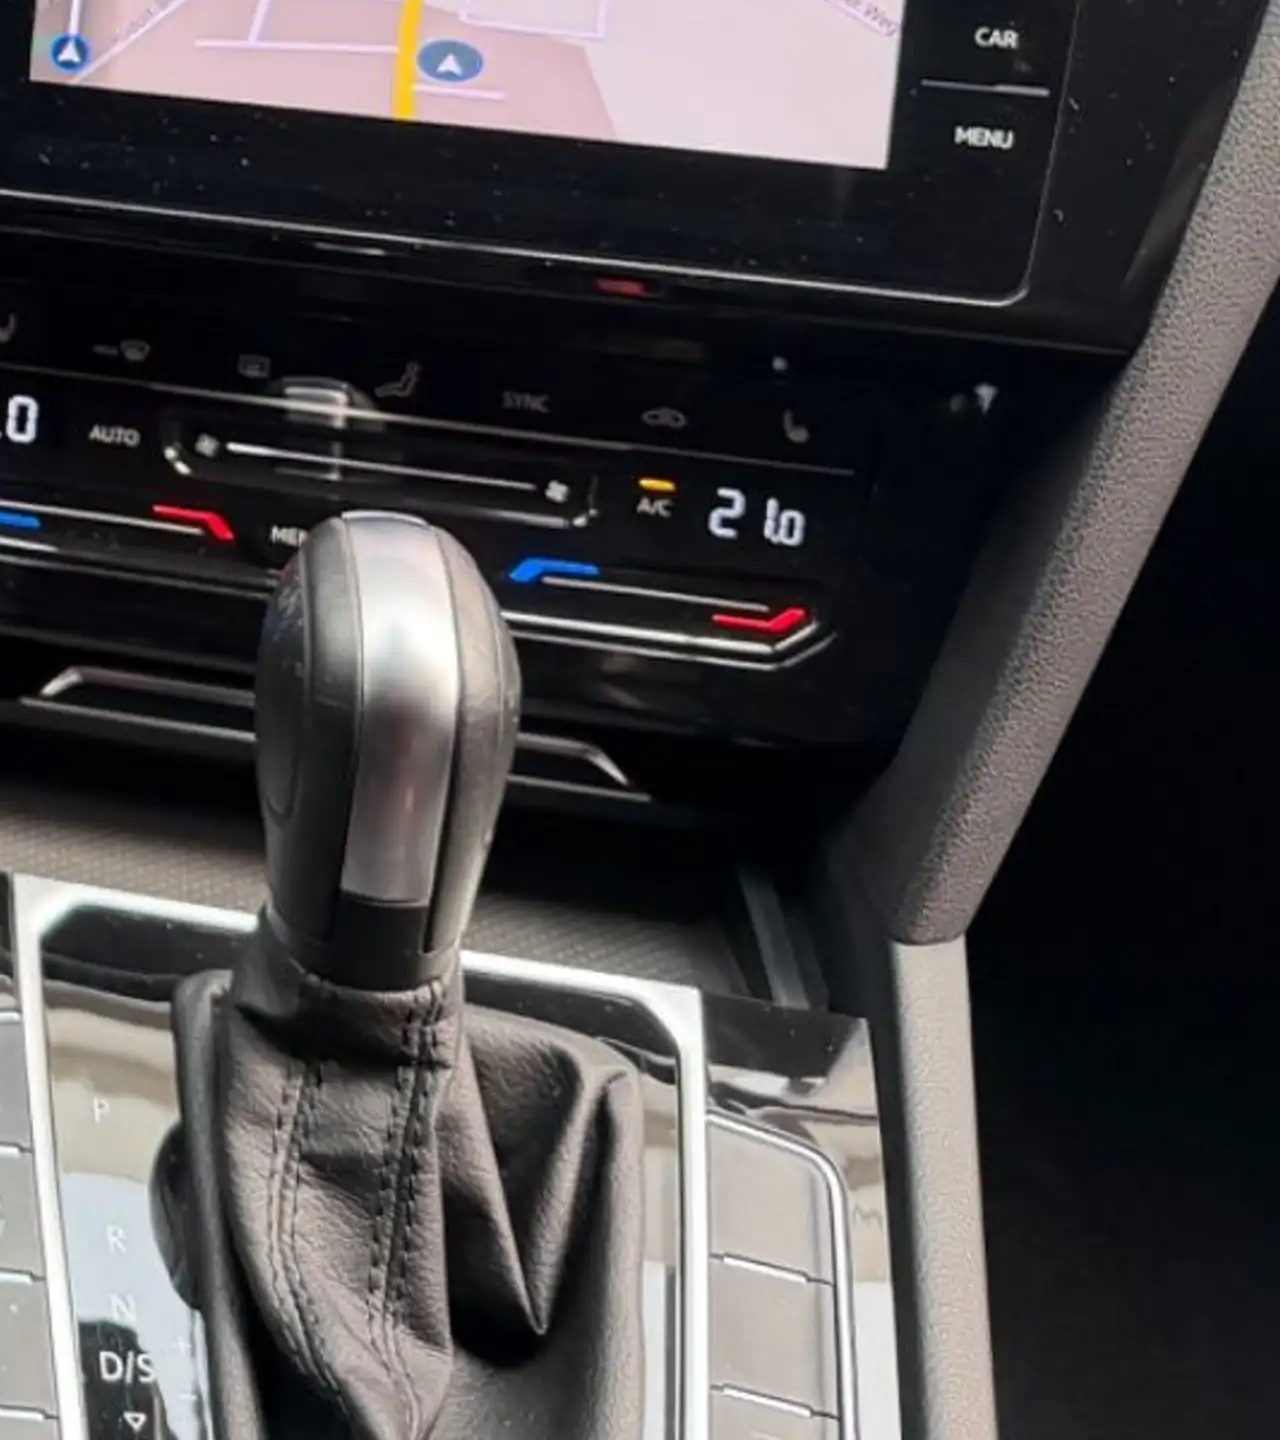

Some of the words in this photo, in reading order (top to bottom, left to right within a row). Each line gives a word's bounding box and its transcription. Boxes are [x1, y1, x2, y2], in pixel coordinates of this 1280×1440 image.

[975, 27, 1019, 49] CAR
[955, 126, 1014, 150] MENU
[502, 391, 551, 414] SYNC
[89, 424, 141, 448] AUTO
[637, 497, 673, 520] A/C
[98, 1349, 157, 1385] D/S
